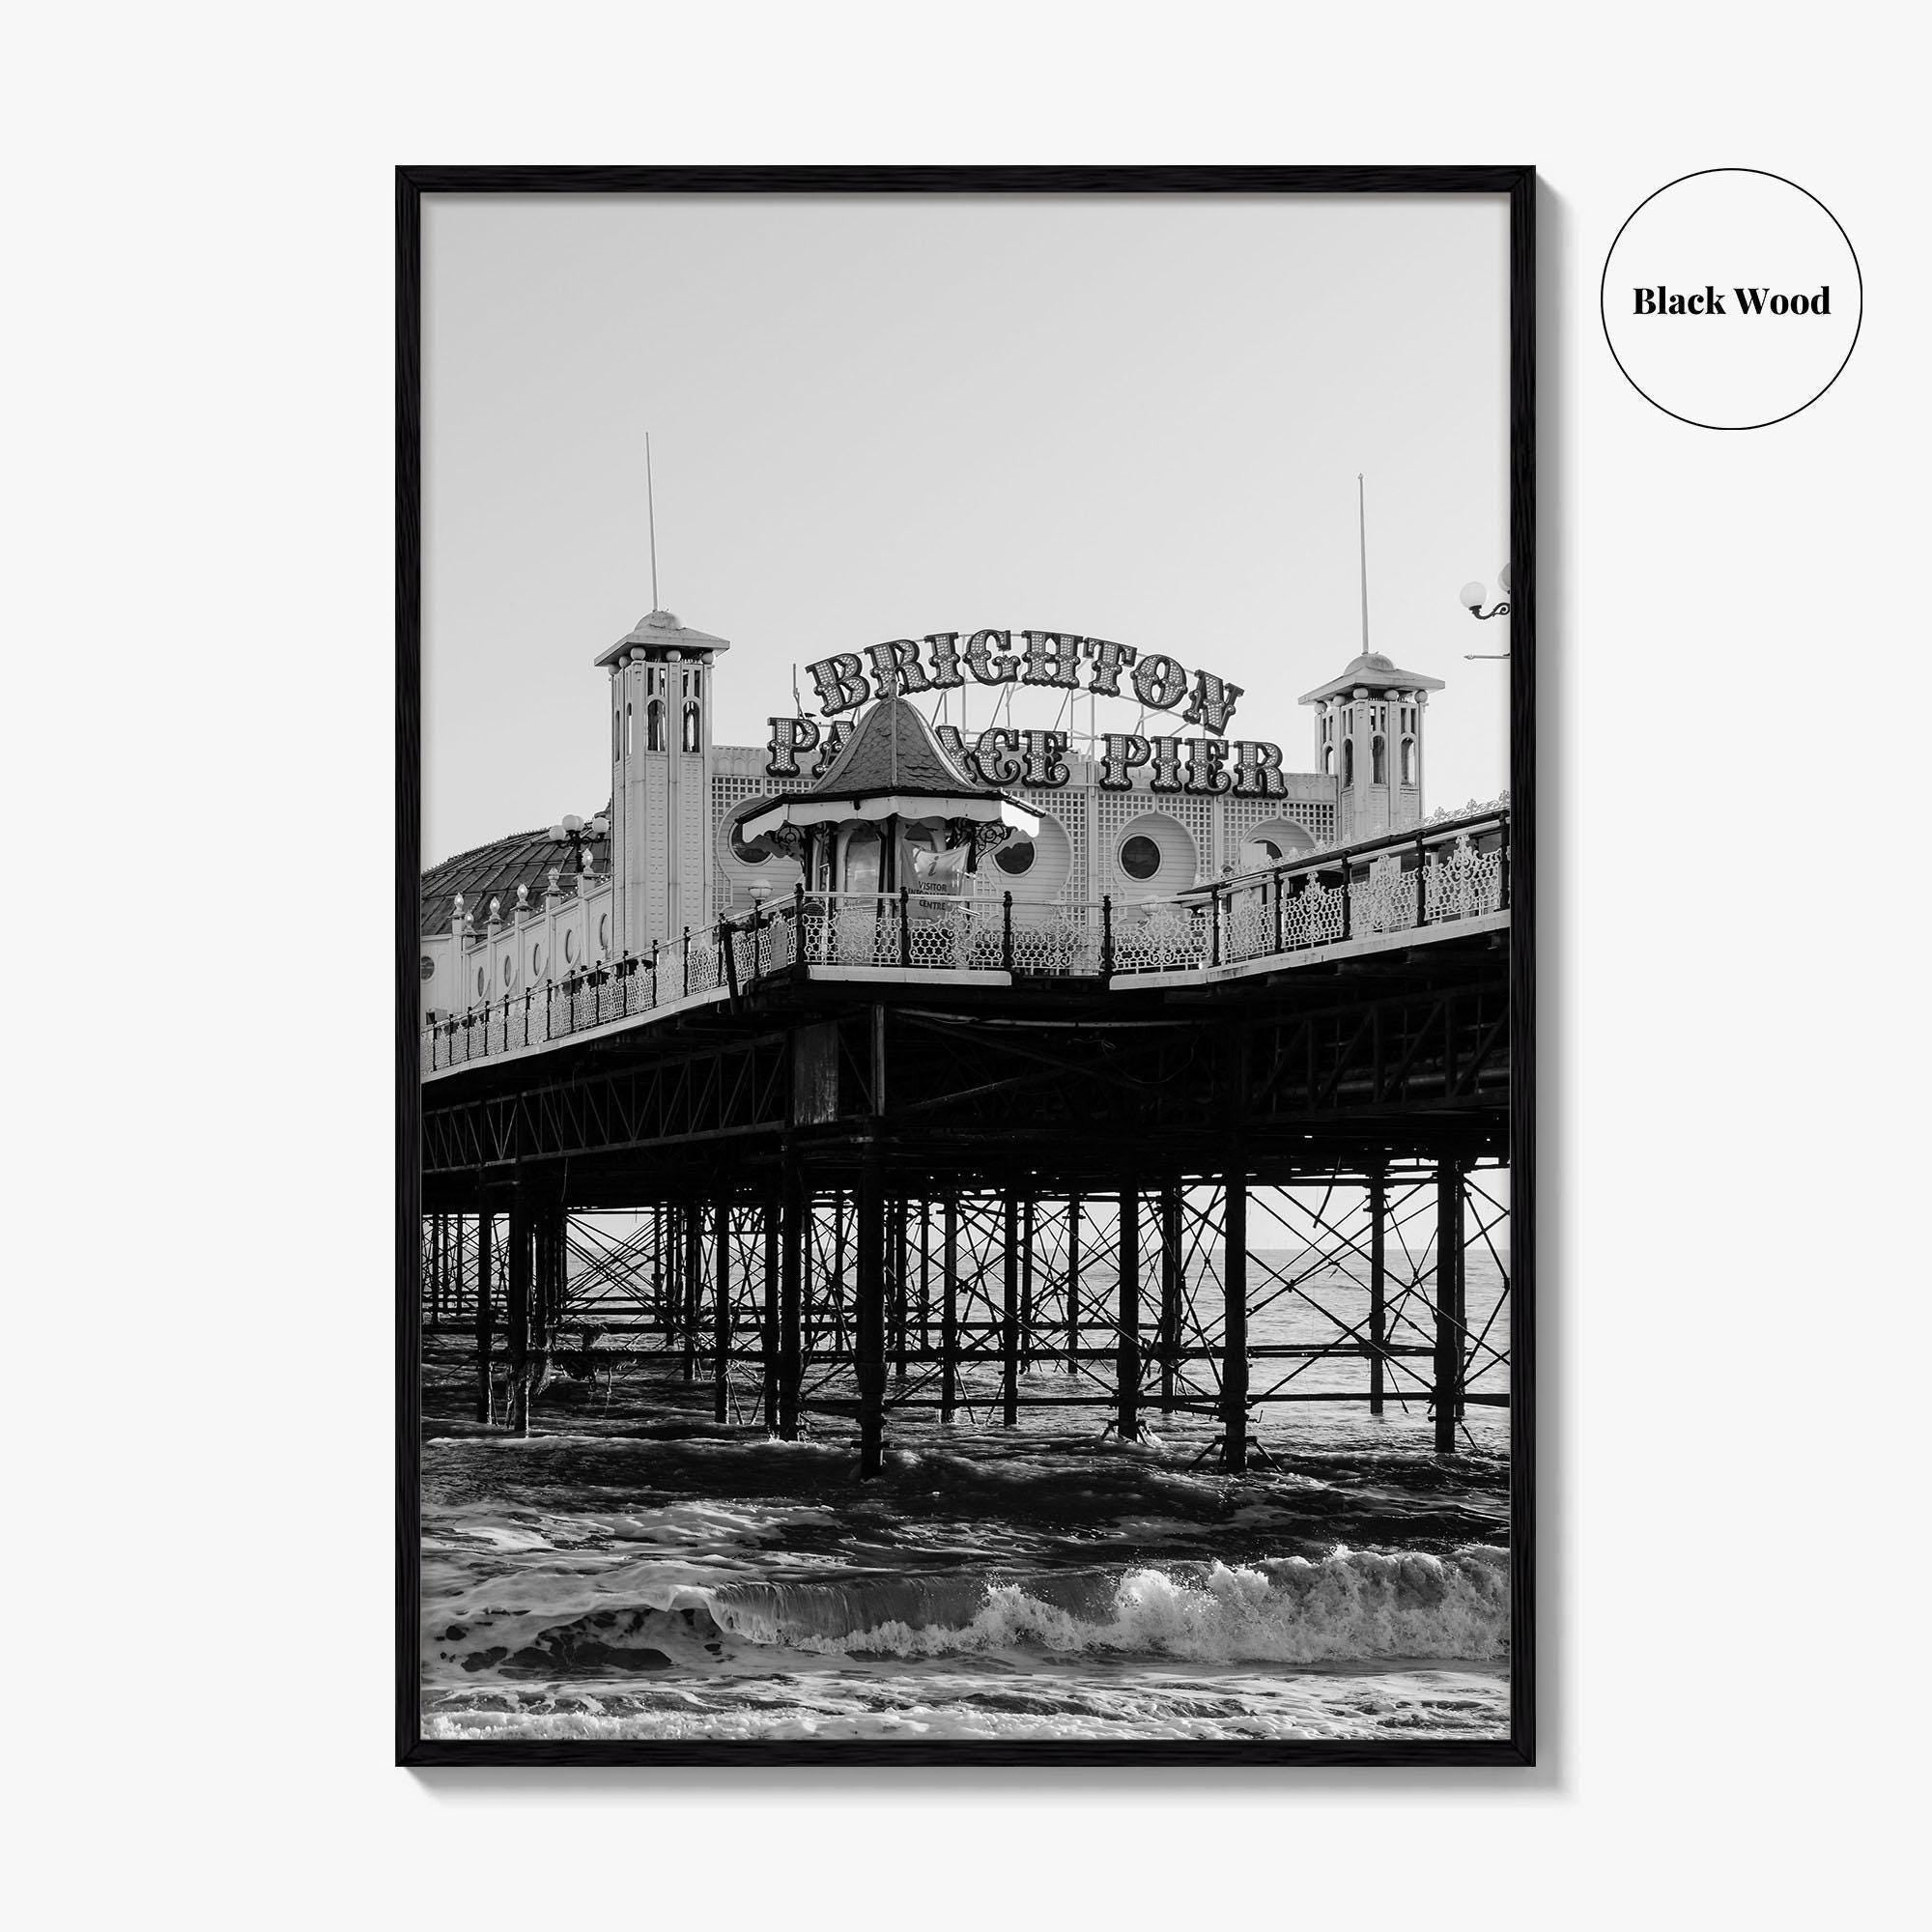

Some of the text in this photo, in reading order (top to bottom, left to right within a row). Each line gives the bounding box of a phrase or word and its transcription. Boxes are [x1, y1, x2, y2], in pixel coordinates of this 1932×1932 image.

[806, 629, 1245, 736] BRIGHTON
[765, 717, 1290, 800] PAACE PIER
[919, 880, 947, 892] VISITOR
[919, 899, 946, 910] CENTRE
